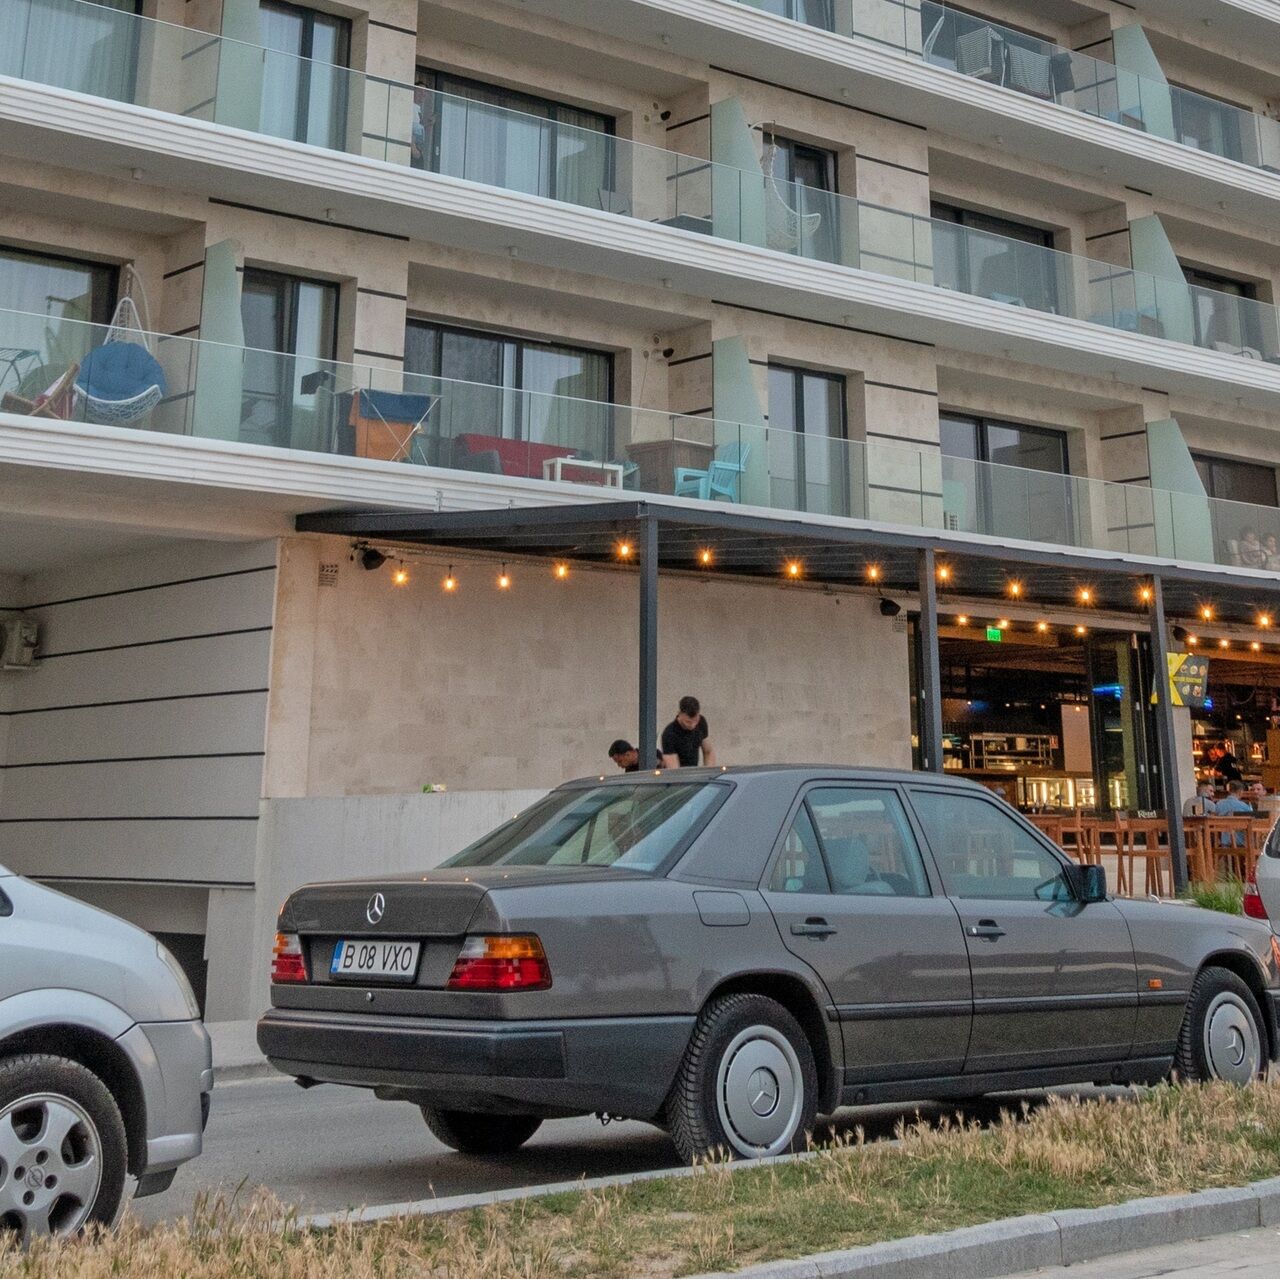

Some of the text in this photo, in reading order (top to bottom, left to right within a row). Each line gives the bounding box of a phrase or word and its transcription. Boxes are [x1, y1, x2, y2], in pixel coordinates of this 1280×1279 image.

[343, 944, 413, 971] B 08 VXO
